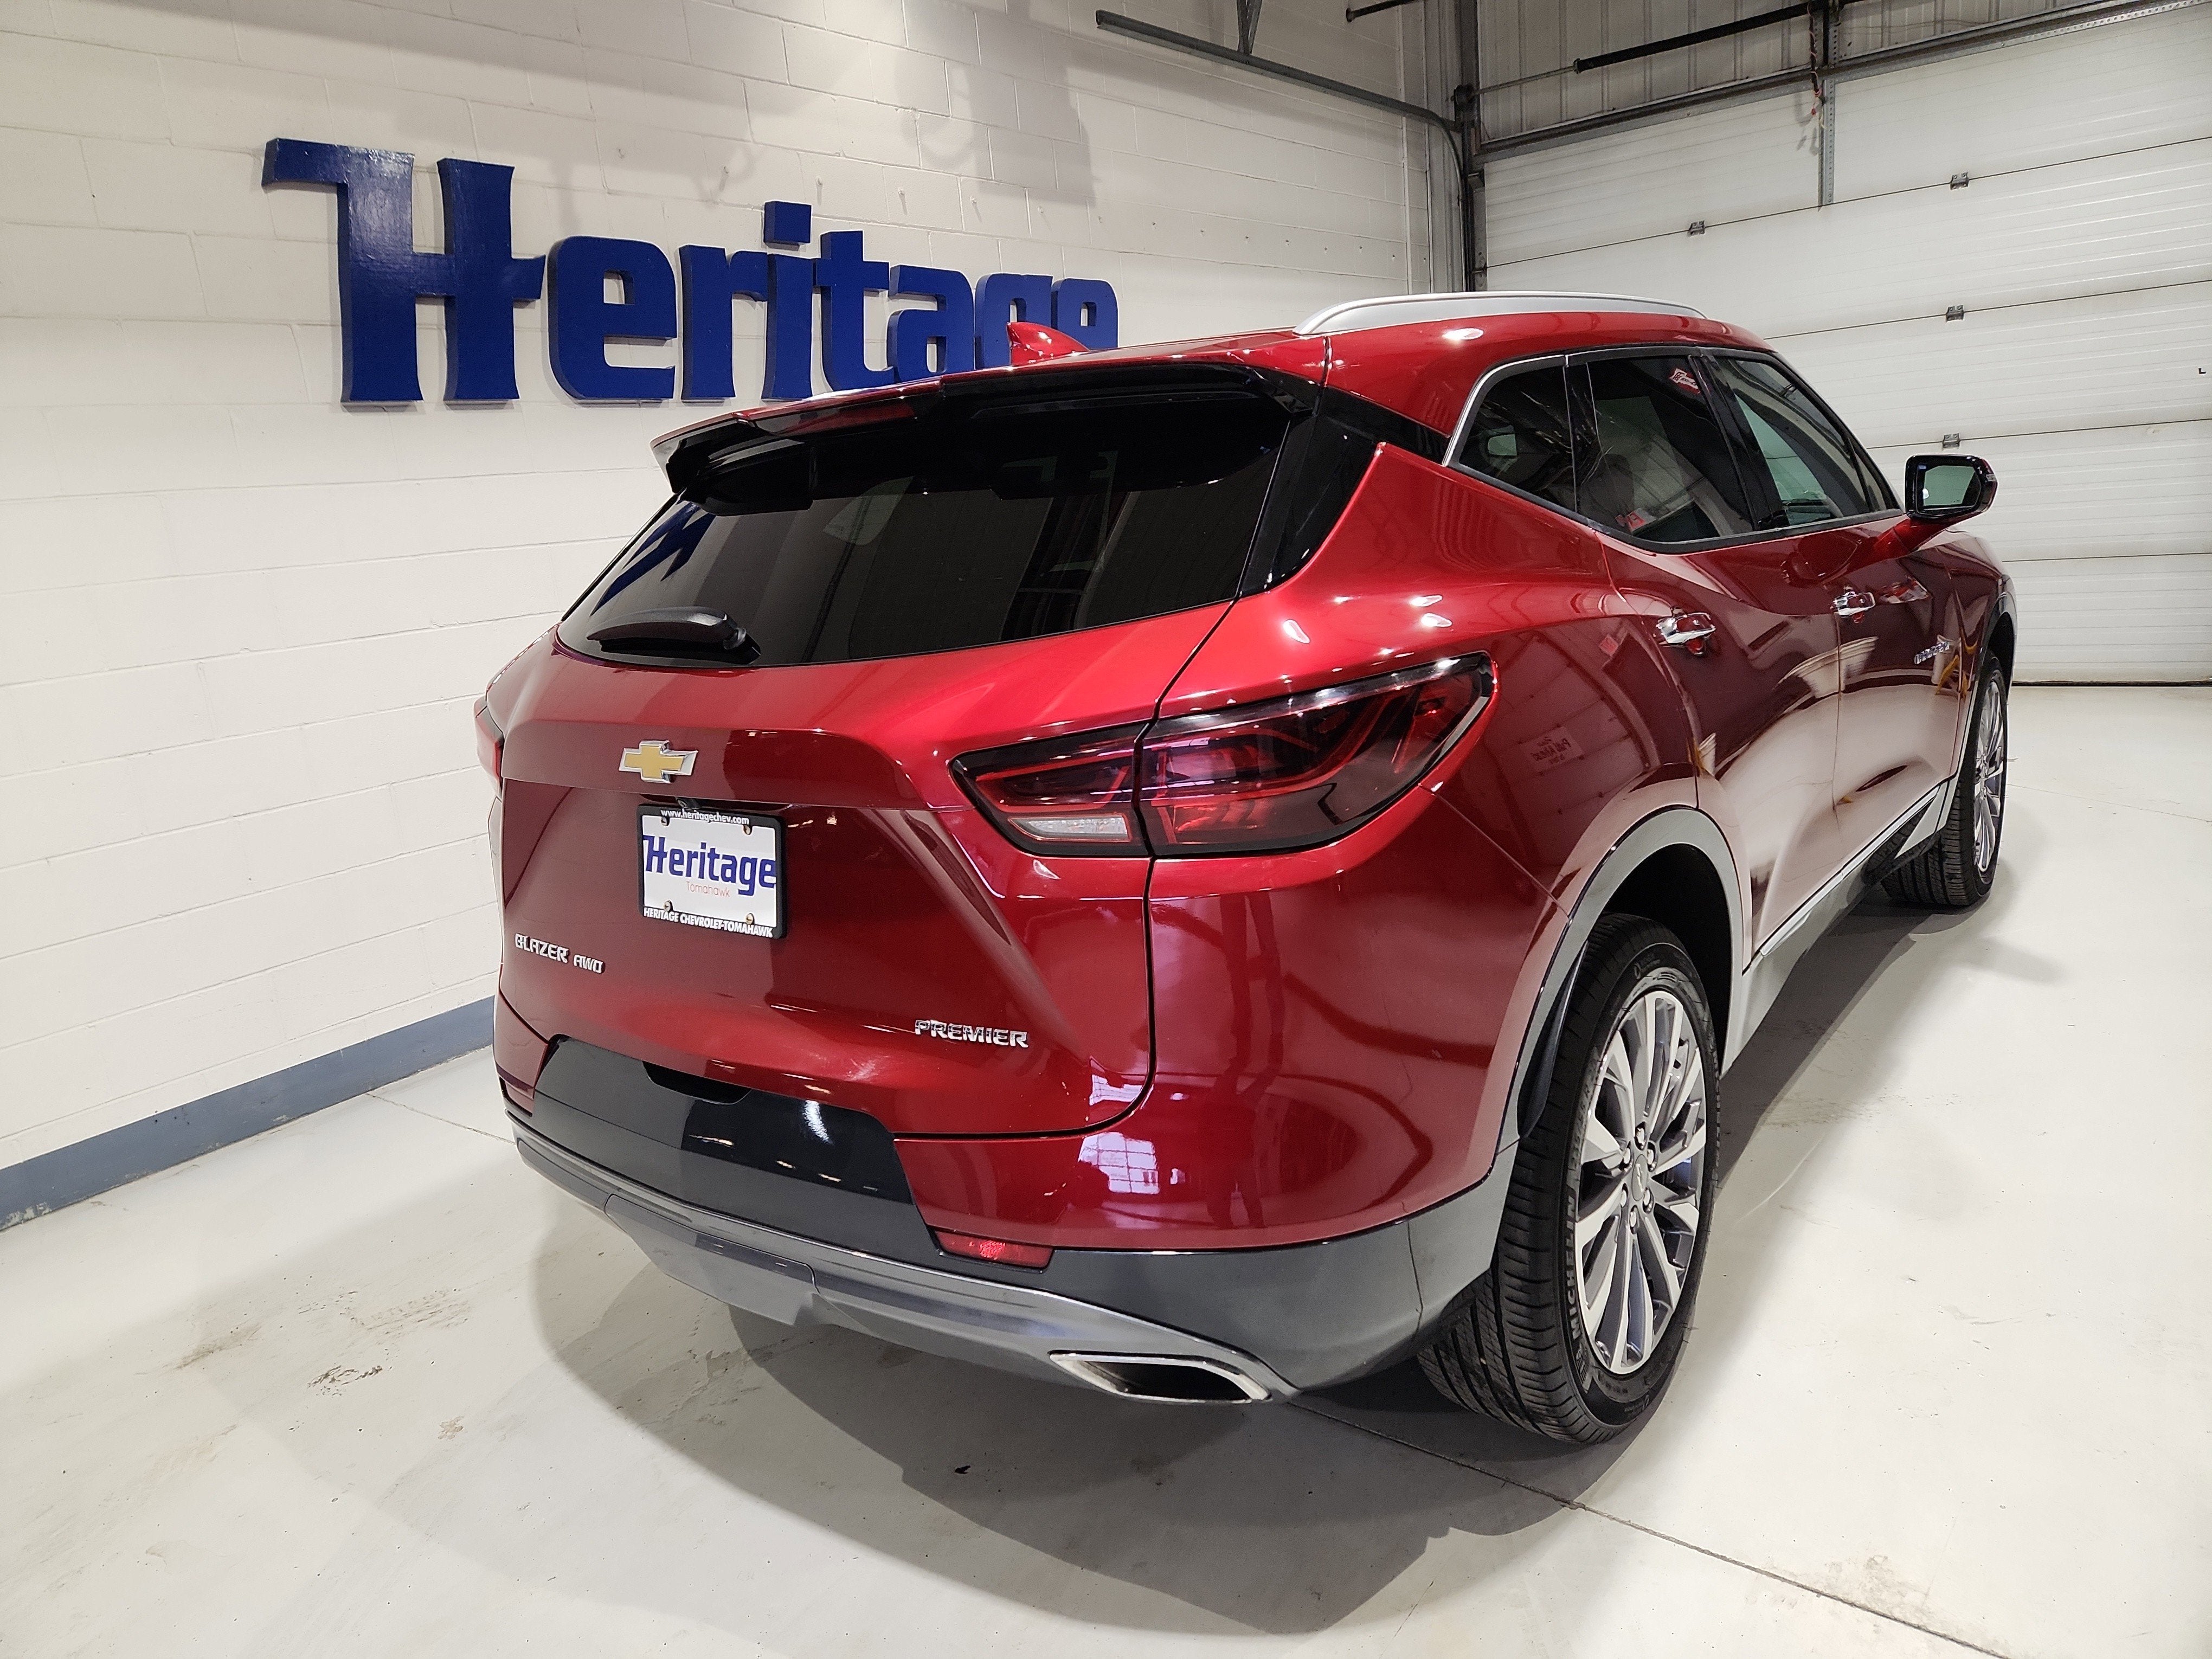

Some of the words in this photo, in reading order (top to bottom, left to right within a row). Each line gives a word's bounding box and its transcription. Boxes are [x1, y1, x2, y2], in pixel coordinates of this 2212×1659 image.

[661, 808, 750, 825] www.heritagechev.com
[643, 834, 776, 896] Heritage
[686, 881, 730, 898] Tomahawk
[644, 907, 679, 922] HERITAGE
[515, 933, 569, 963] BLAZER
[573, 954, 605, 974] AWD
[915, 1019, 1028, 1048] PREMIER
[1566, 1194, 1581, 1341] MICHELIN
